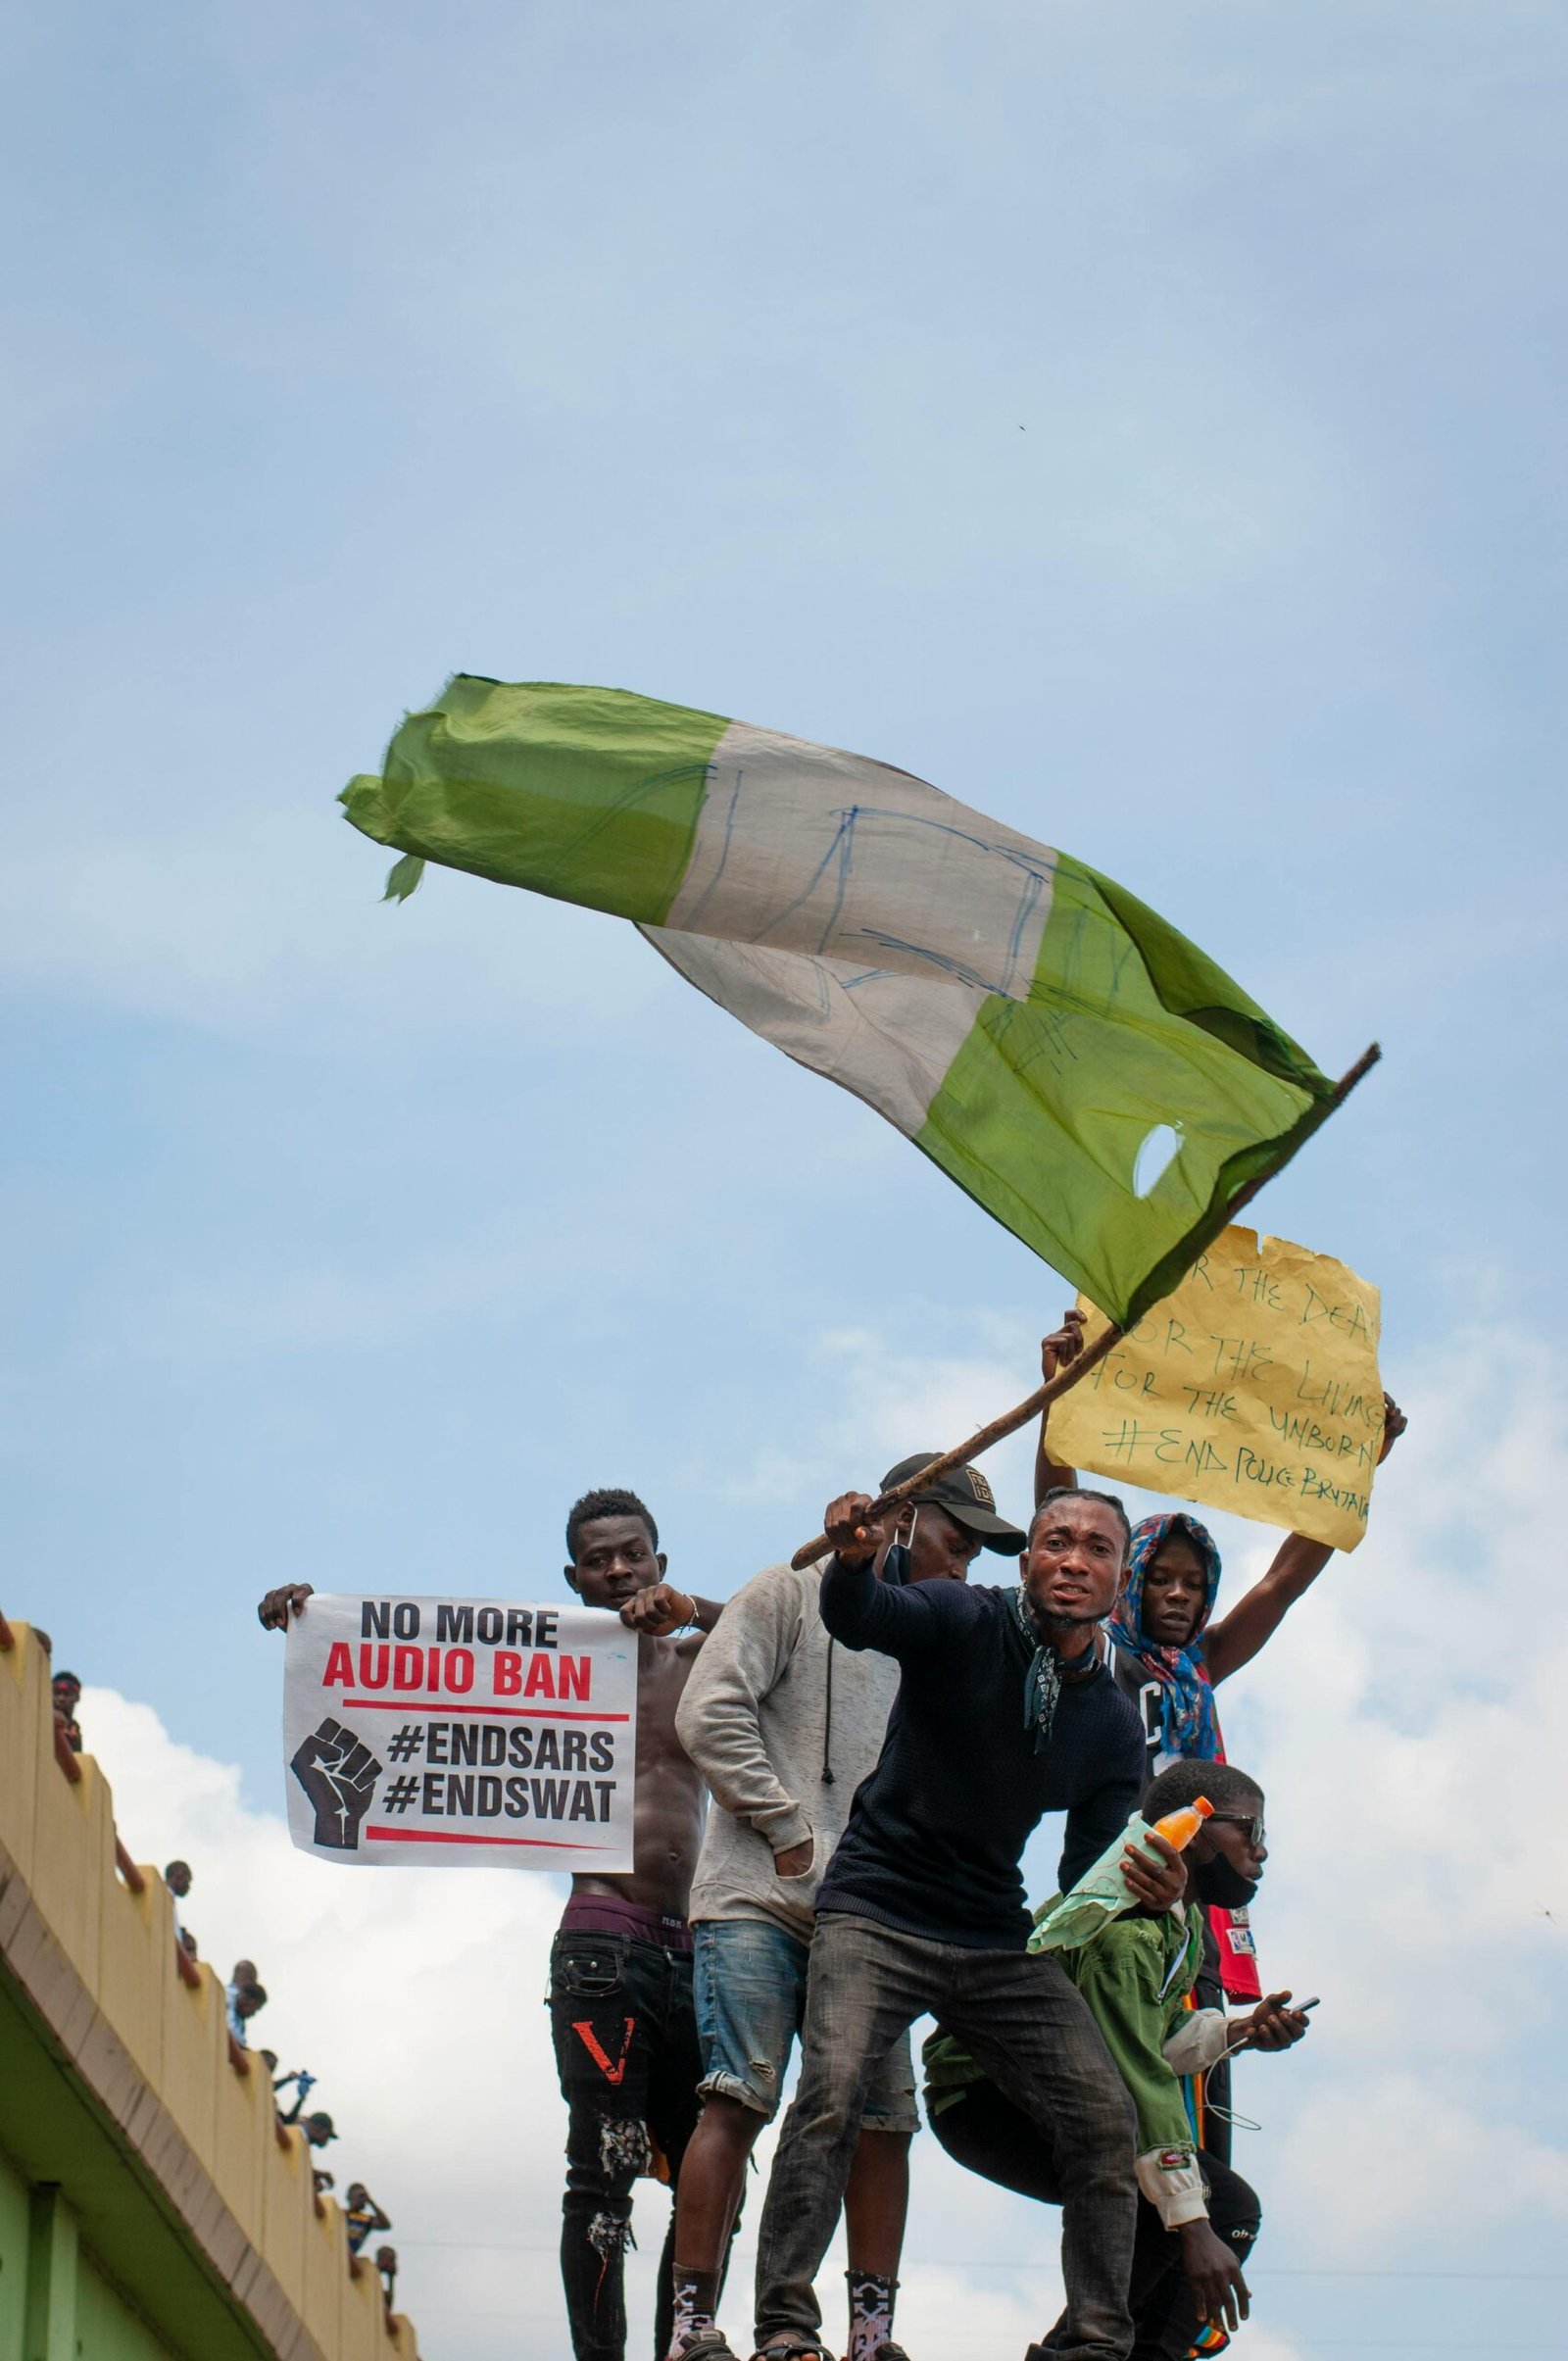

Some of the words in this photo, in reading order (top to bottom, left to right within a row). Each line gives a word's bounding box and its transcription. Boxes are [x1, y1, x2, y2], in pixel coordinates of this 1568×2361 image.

[1233, 1267, 1285, 1311] THE
[1298, 1283, 1369, 1343] DEA
[1090, 1353, 1165, 1399] FOR
[1183, 1386, 1249, 1424] THE
[1270, 1405, 1374, 1469] UNBORN
[1131, 1317, 1194, 1357] OR
[1210, 1335, 1274, 1383] THE
[1297, 1359, 1385, 1441] LIVING
[1102, 1419, 1229, 1477] #END
[1235, 1446, 1296, 1487] POLICE
[362, 1600, 419, 1641] NO
[436, 1605, 559, 1648] MORE
[321, 1643, 474, 1693] AUDIO
[493, 1650, 592, 1701] BAN
[386, 1722, 614, 1772] #ENDSARS
[382, 1772, 616, 1823] #ENDSWAT
[571, 2016, 635, 2086] V
